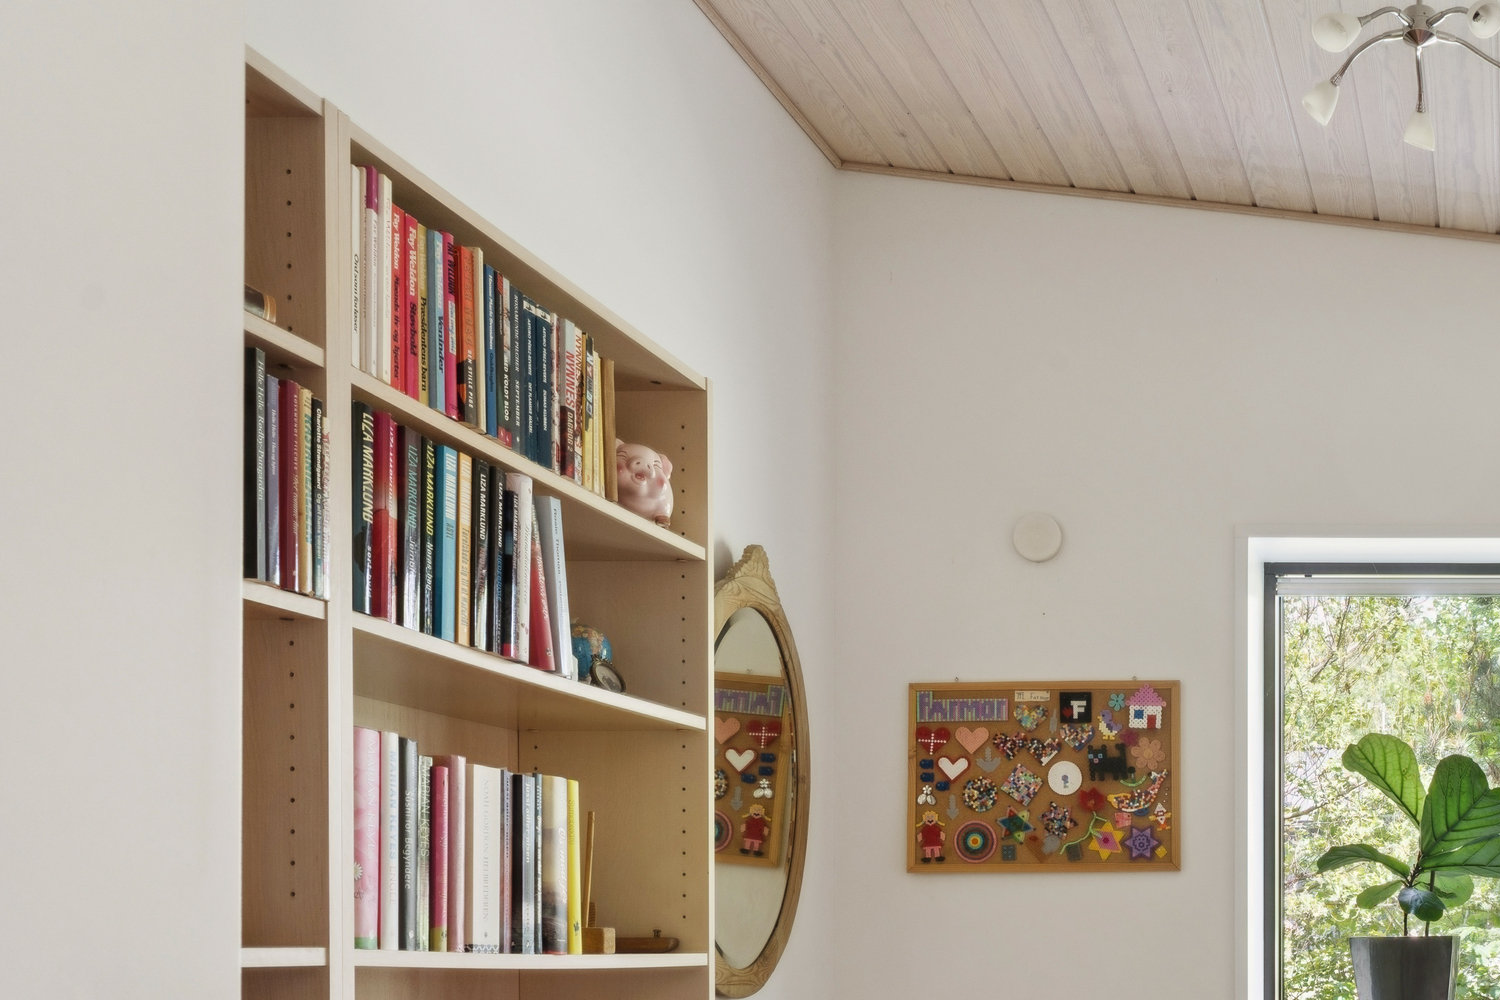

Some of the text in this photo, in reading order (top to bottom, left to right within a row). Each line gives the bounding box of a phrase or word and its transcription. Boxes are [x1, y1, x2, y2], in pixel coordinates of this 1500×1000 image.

[408, 226, 416, 249] Fay
[393, 330, 399, 342] og
[566, 351, 575, 408] NYNNES
[362, 412, 374, 443] LIZA
[426, 445, 435, 468] LIZA
[362, 445, 374, 524] MARKLUND
[408, 445, 418, 529] LIZA MARKLUND
[426, 471, 434, 536] MARKLUND
[446, 453, 456, 540] LIZA MARKLUND ASYL
[1070, 700, 1087, 719] F
[390, 750, 398, 859] MARIAN KEYES
[404, 790, 414, 818] Sushi
[420, 765, 430, 857] MARIAN KEYES
[402, 838, 412, 889] Begyndere
